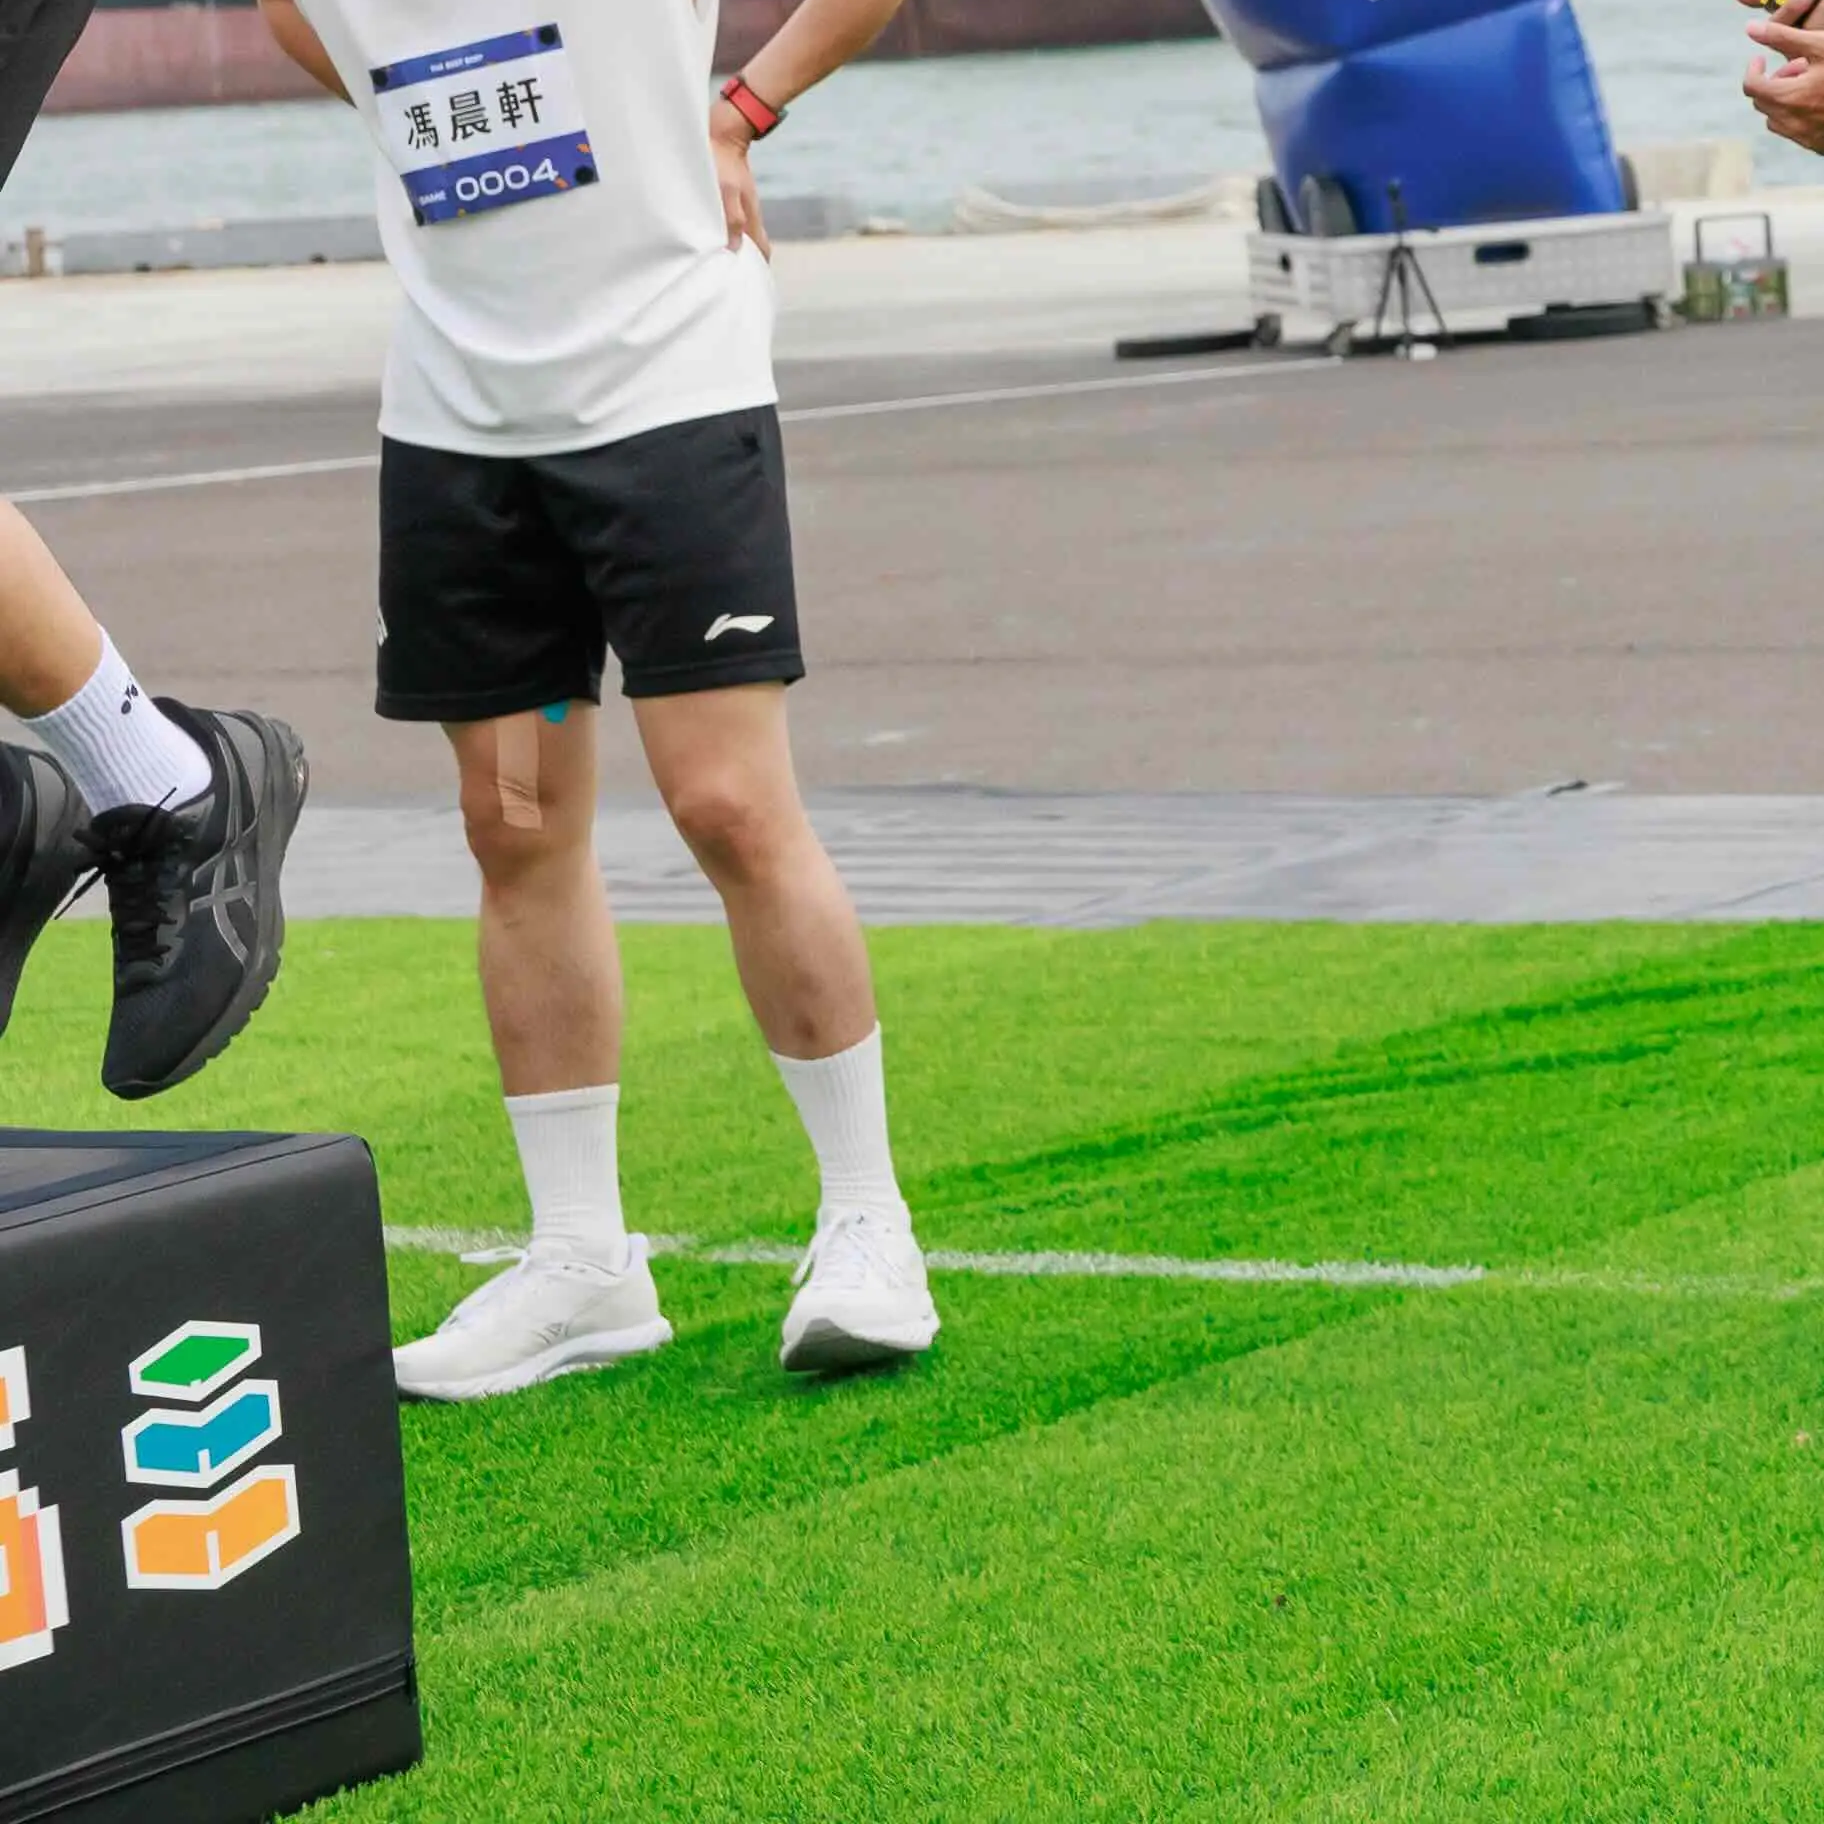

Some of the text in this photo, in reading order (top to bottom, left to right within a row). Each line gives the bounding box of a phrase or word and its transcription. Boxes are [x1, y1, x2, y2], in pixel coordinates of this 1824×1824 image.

[404, 78, 543, 149] 馮晨軒
[455, 157, 559, 202] 0004
